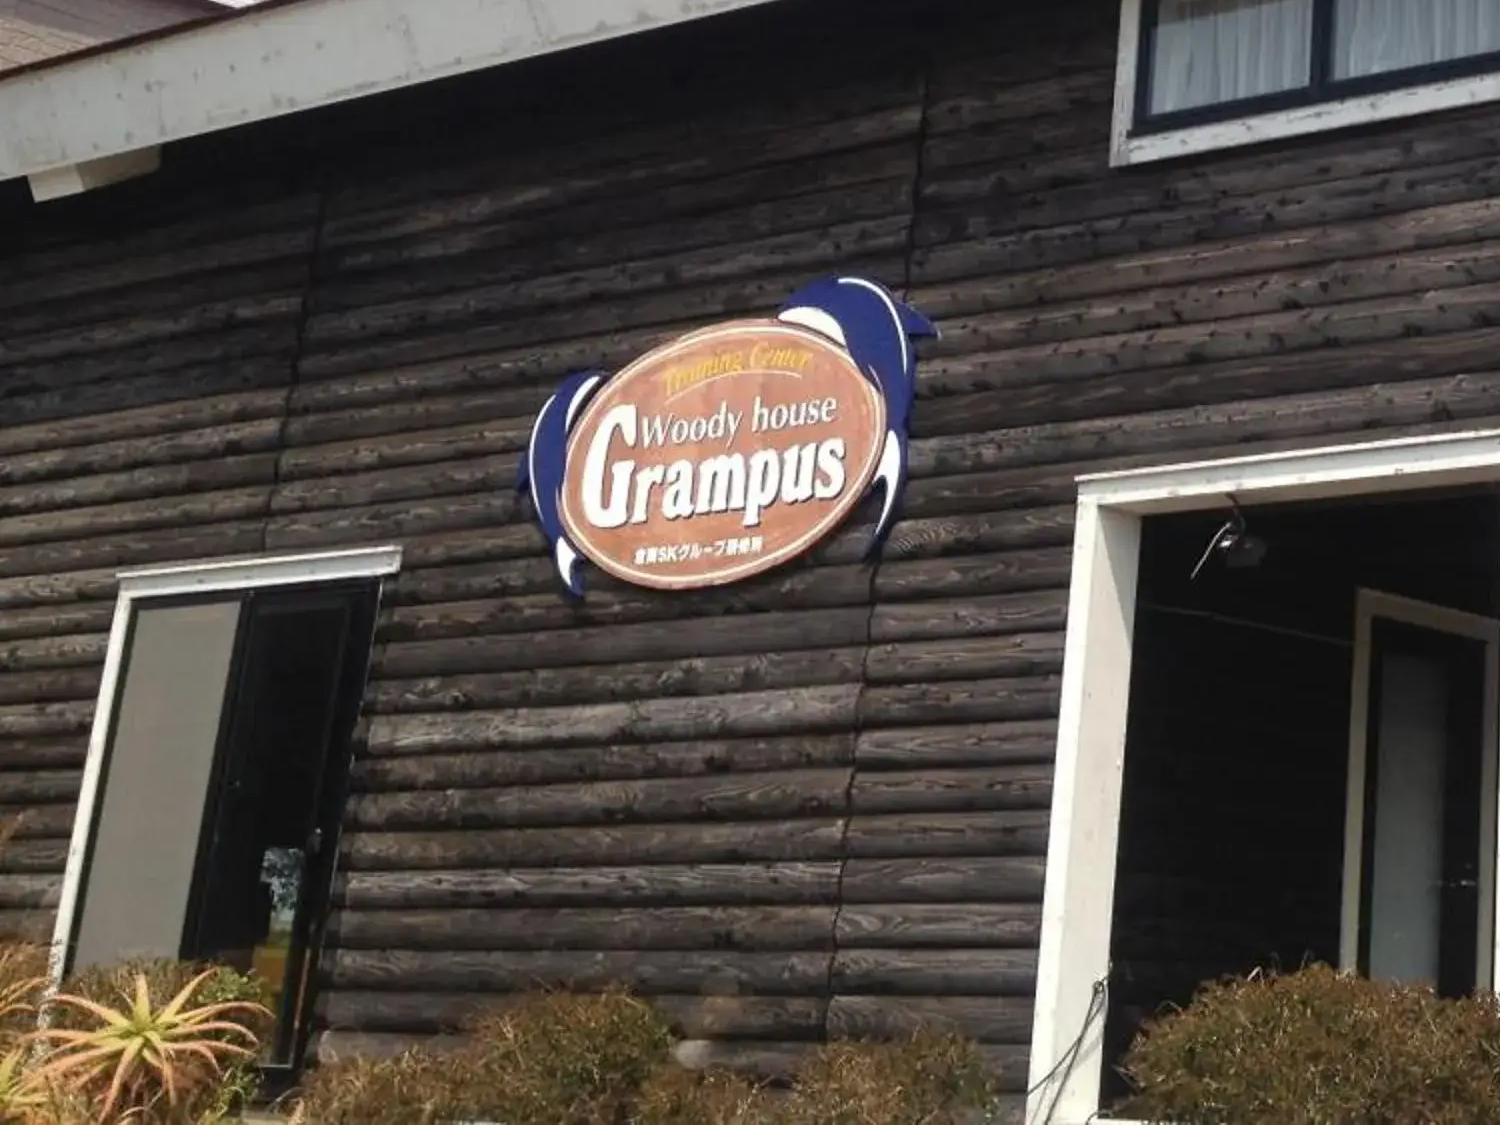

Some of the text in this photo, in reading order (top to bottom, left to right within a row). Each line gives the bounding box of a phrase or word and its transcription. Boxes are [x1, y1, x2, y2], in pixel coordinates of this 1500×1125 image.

[750, 341, 814, 370] Center
[641, 395, 837, 448] Woody house
[581, 403, 847, 529] Grampus
